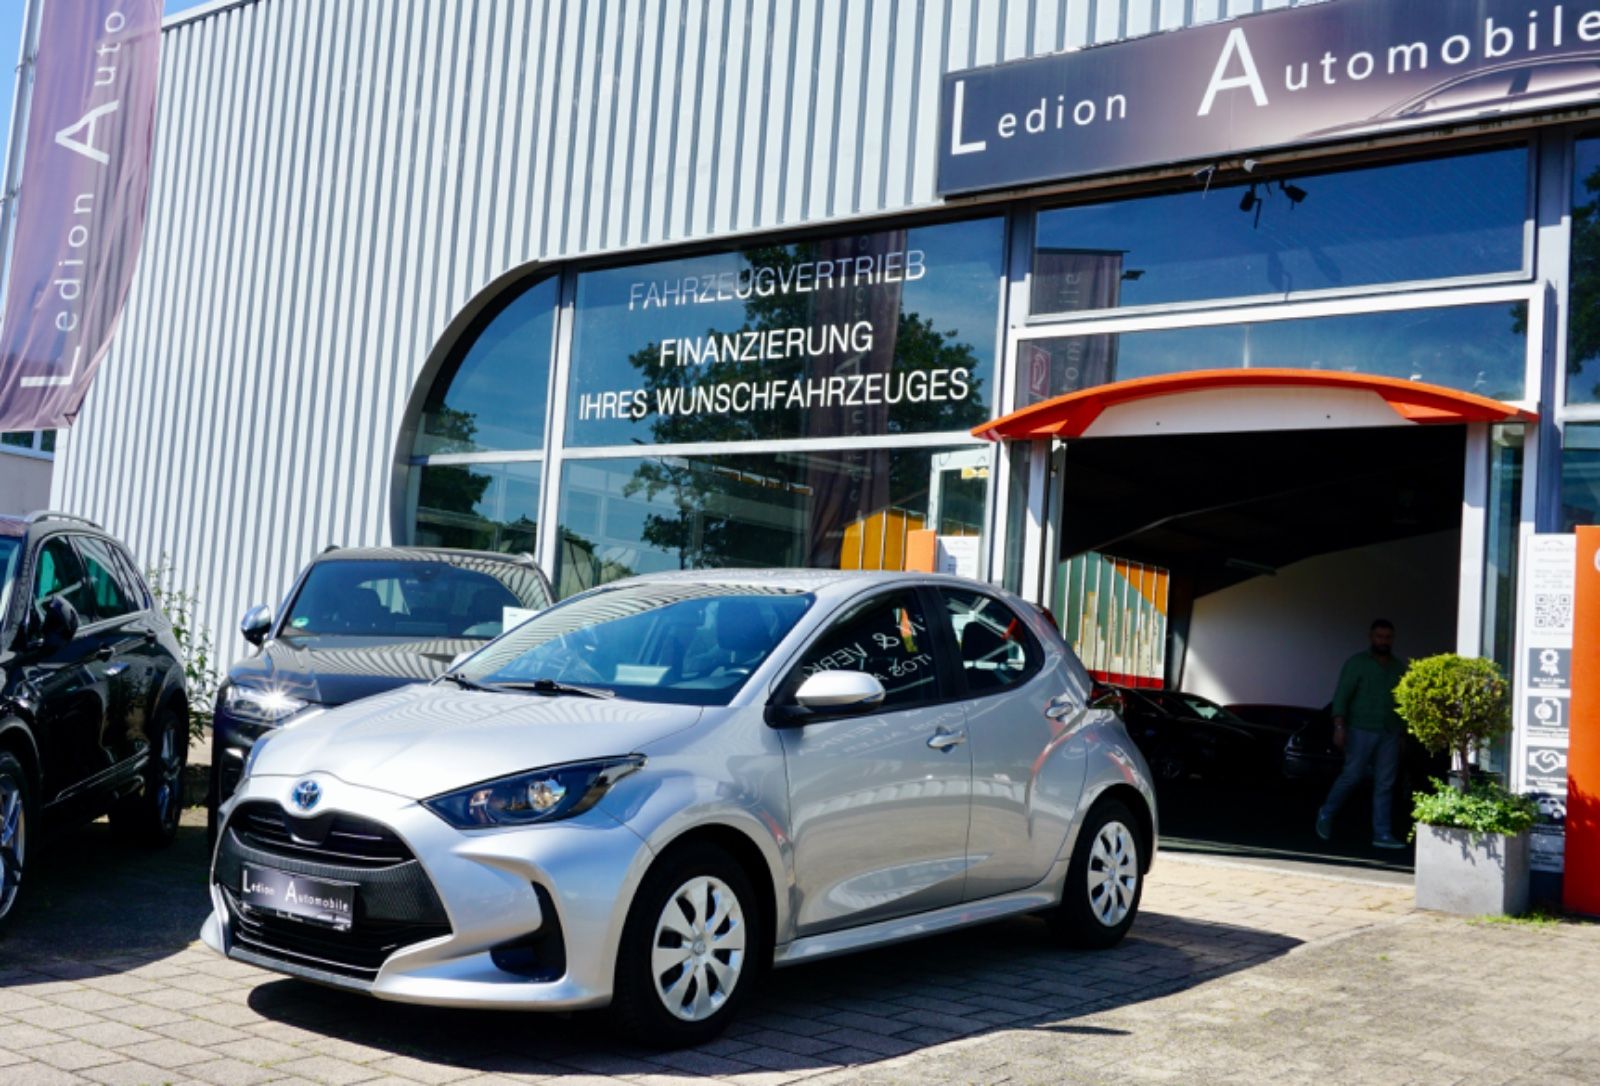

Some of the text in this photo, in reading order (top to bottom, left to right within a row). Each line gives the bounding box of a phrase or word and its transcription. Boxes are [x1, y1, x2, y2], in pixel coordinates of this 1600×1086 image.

[950, 5, 1600, 156] Ledion Automobile
[20, 10, 126, 388] Ledion Auto
[628, 249, 927, 311] FAHRZEUGVERTRIEB
[659, 320, 874, 367] FINANZIERUNG
[578, 366, 970, 421] IHRES WUNSCHFAHRZEUGES
[243, 870, 348, 911] Ledion Automobile
